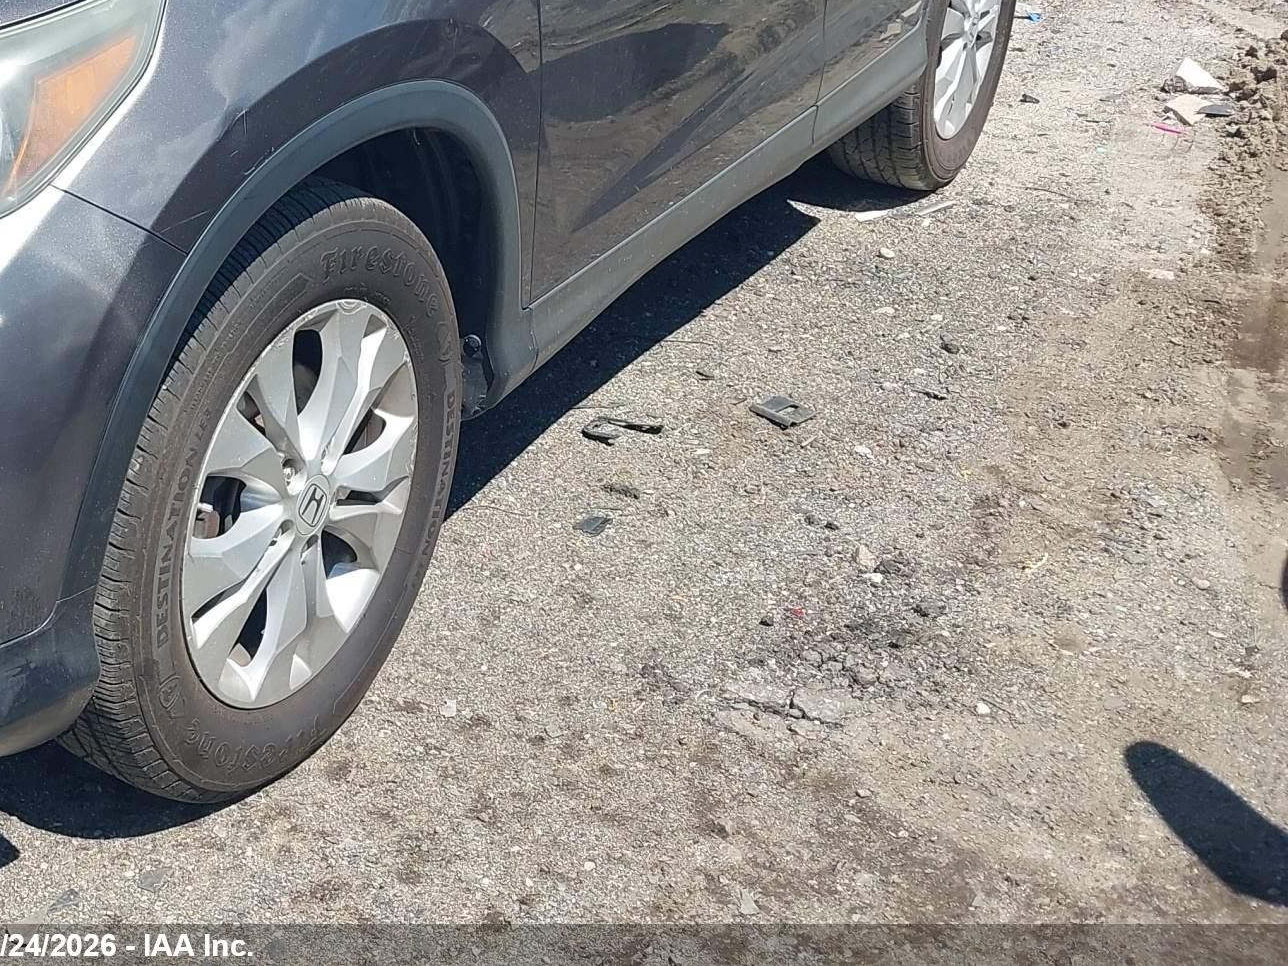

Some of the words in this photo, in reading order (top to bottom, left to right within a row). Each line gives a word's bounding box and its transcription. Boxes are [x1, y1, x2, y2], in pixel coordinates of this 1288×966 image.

[320, 245, 440, 318] Firestone
[156, 447, 199, 649] DESTINATION
[422, 391, 455, 556] DESTINATION
